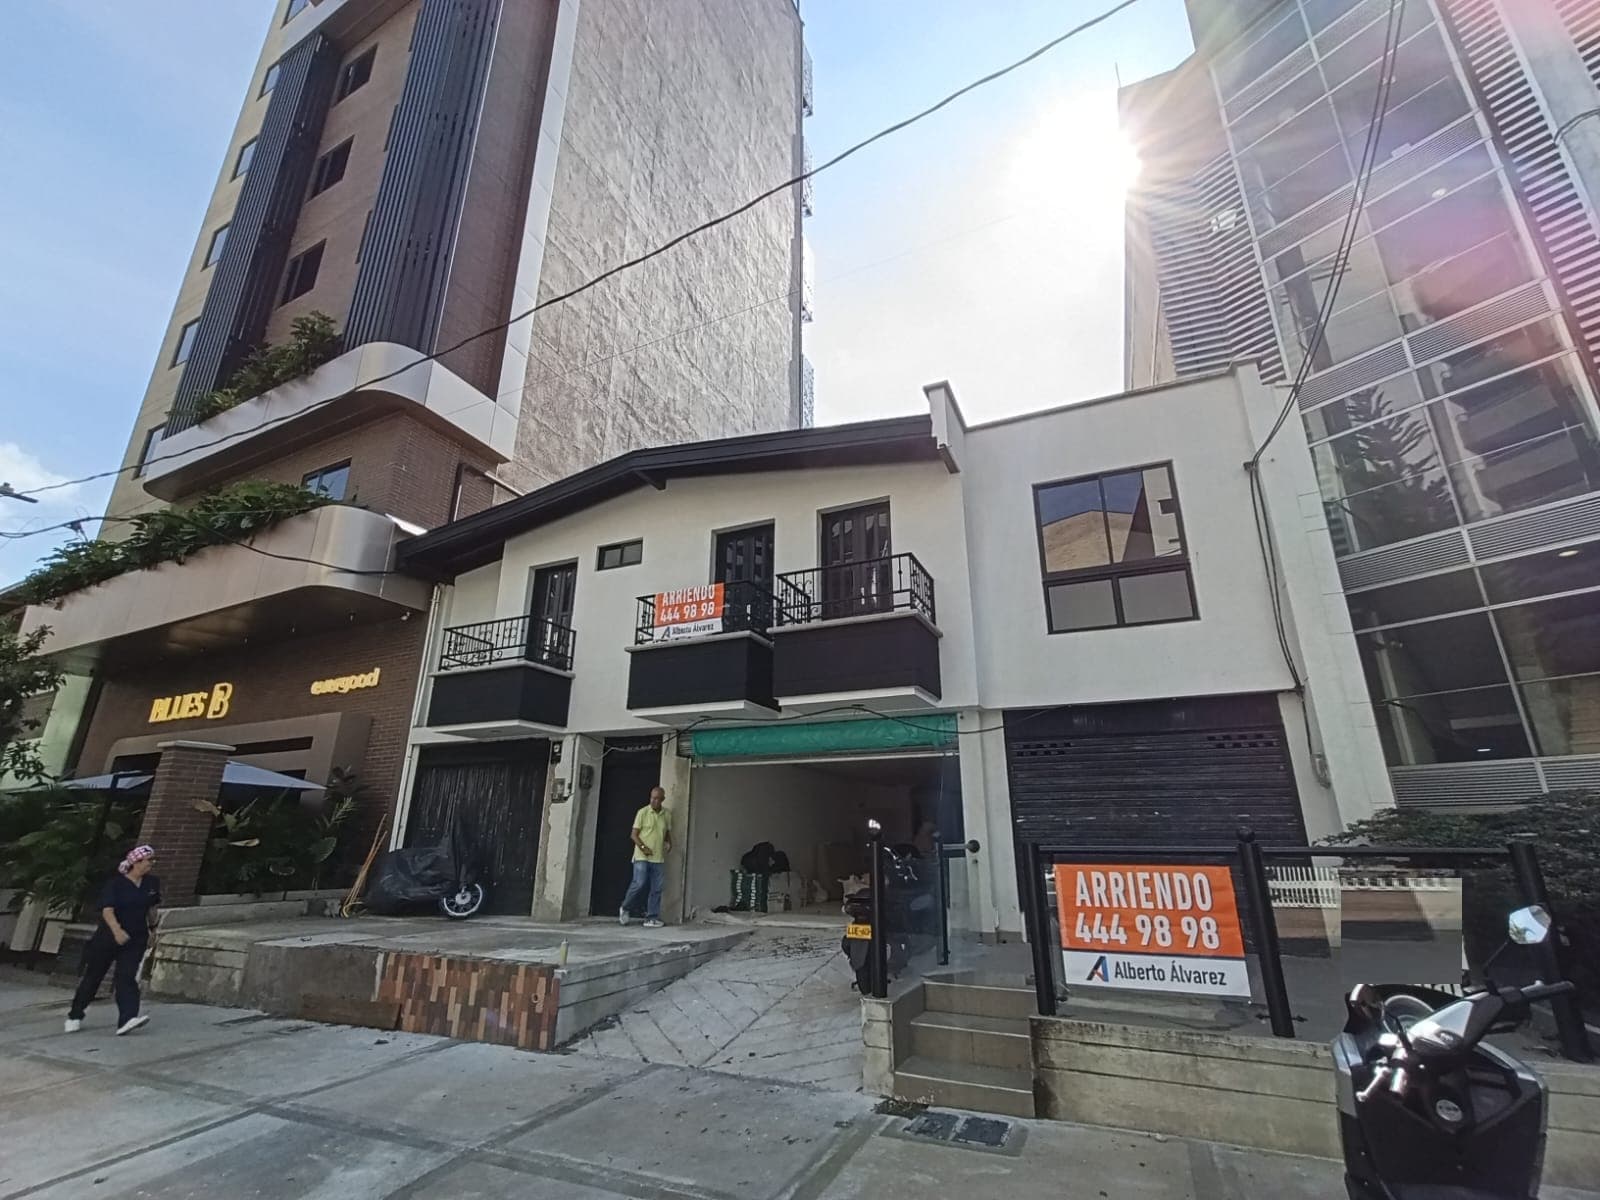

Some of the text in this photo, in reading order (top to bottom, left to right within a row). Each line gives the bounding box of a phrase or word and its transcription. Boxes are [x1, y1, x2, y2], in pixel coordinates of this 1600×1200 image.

[662, 585, 716, 607] ARRIENDO
[660, 601, 715, 622] 444 98 98
[148, 691, 208, 723] BLUES
[1075, 871, 1213, 912] ARRIENDO
[1075, 912, 1220, 949] 444 98 98
[1114, 960, 1227, 986] Alberto Álvarez
